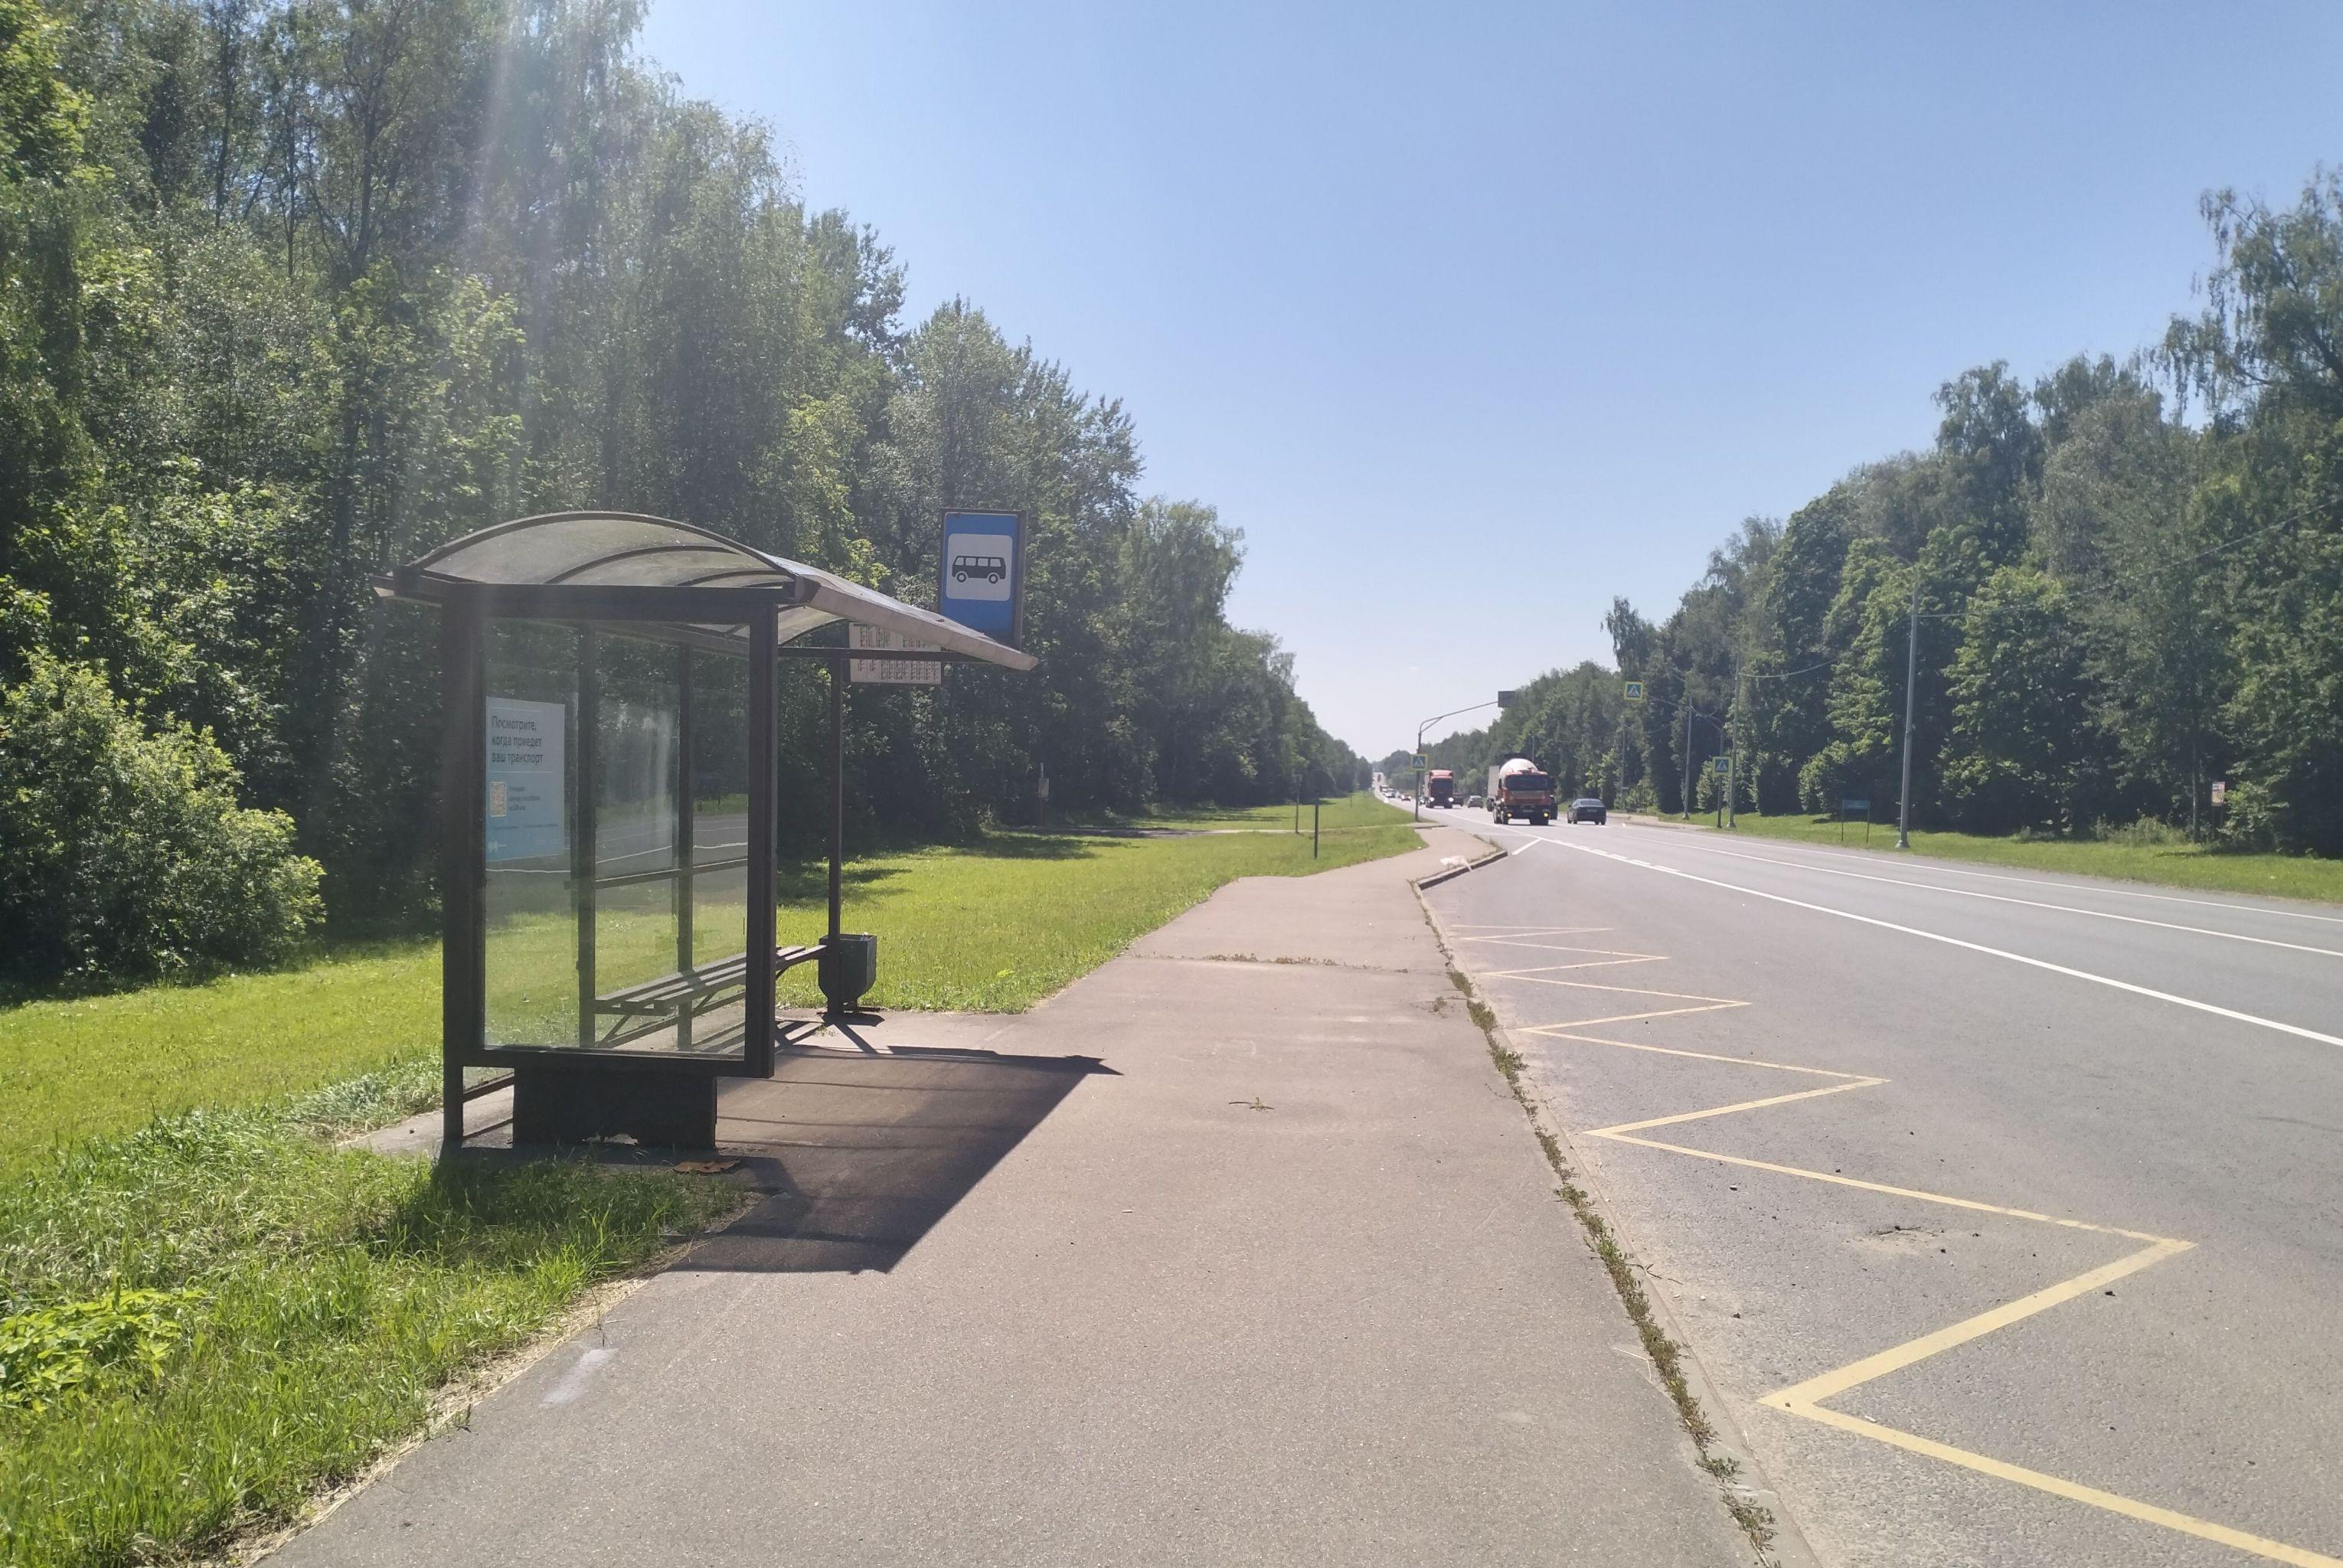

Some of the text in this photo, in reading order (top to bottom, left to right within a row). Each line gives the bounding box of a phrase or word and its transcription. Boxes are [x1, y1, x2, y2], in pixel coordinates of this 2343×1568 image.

[492, 716, 537, 733] Посмотрите,
[492, 736, 542, 749] когда приедет
[492, 753, 543, 766] ваш транспорт
